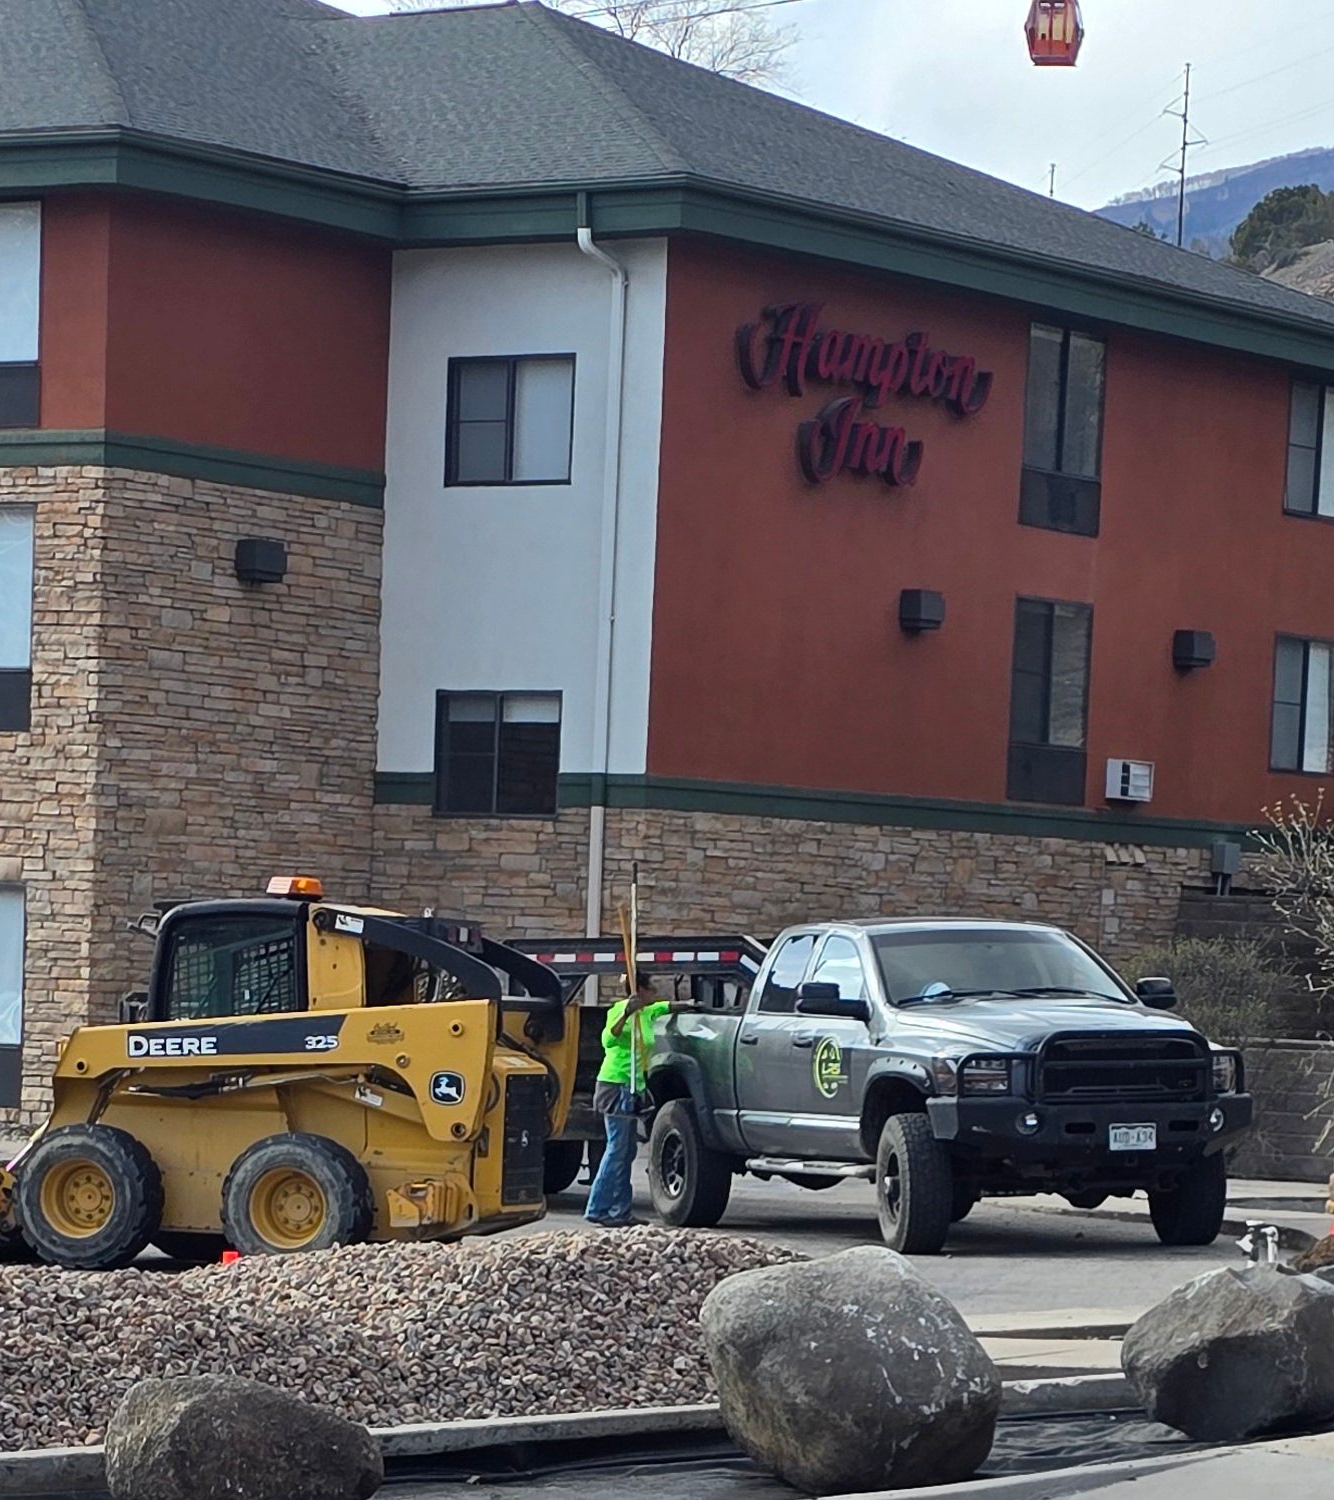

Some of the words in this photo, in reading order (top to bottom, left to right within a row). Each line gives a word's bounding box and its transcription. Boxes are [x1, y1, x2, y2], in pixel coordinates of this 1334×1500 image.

[735, 302, 994, 418] Hampton
[796, 396, 924, 487] Inn
[128, 1035, 217, 1056] DEERE
[304, 1035, 339, 1050] 325
